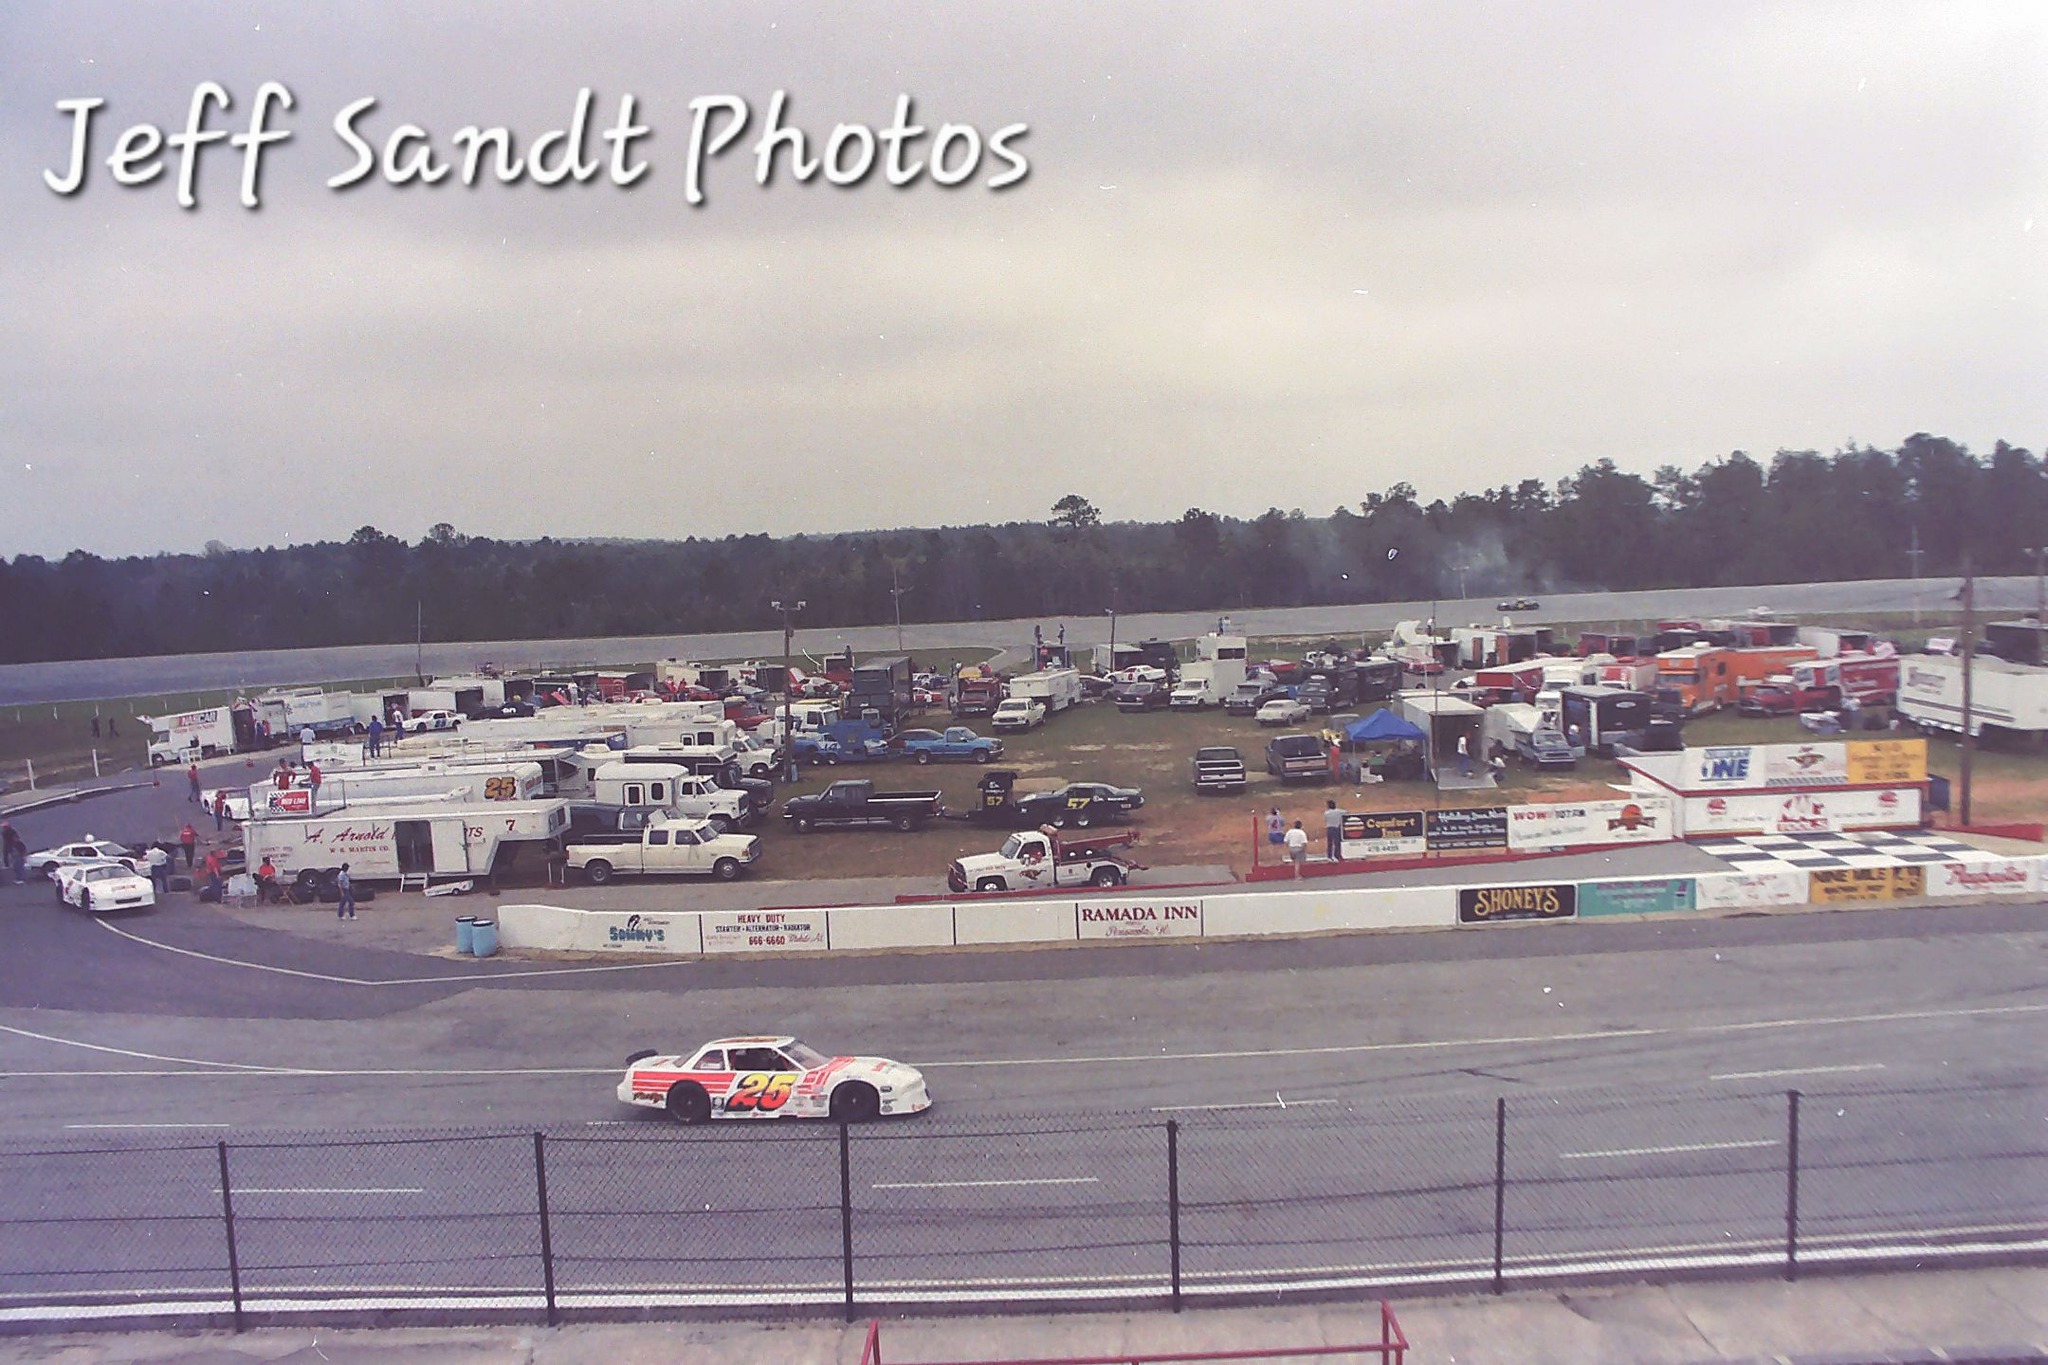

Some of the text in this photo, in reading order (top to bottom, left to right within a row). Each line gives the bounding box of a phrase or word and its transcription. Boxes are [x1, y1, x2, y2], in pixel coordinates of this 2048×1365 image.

[484, 776, 517, 800] 25
[986, 796, 1004, 806] 57
[1067, 797, 1091, 810] 57
[505, 819, 516, 831] 7
[1366, 817, 1416, 830] Comfort
[331, 826, 390, 844] Arnold
[737, 913, 786, 924] HEAVY DUTY
[1082, 905, 1198, 922] RAMADA INN
[715, 923, 811, 933] STARTER ALTERNATOR RADIATOR
[748, 935, 786, 946] 666-6660
[724, 1072, 798, 1112] 25
